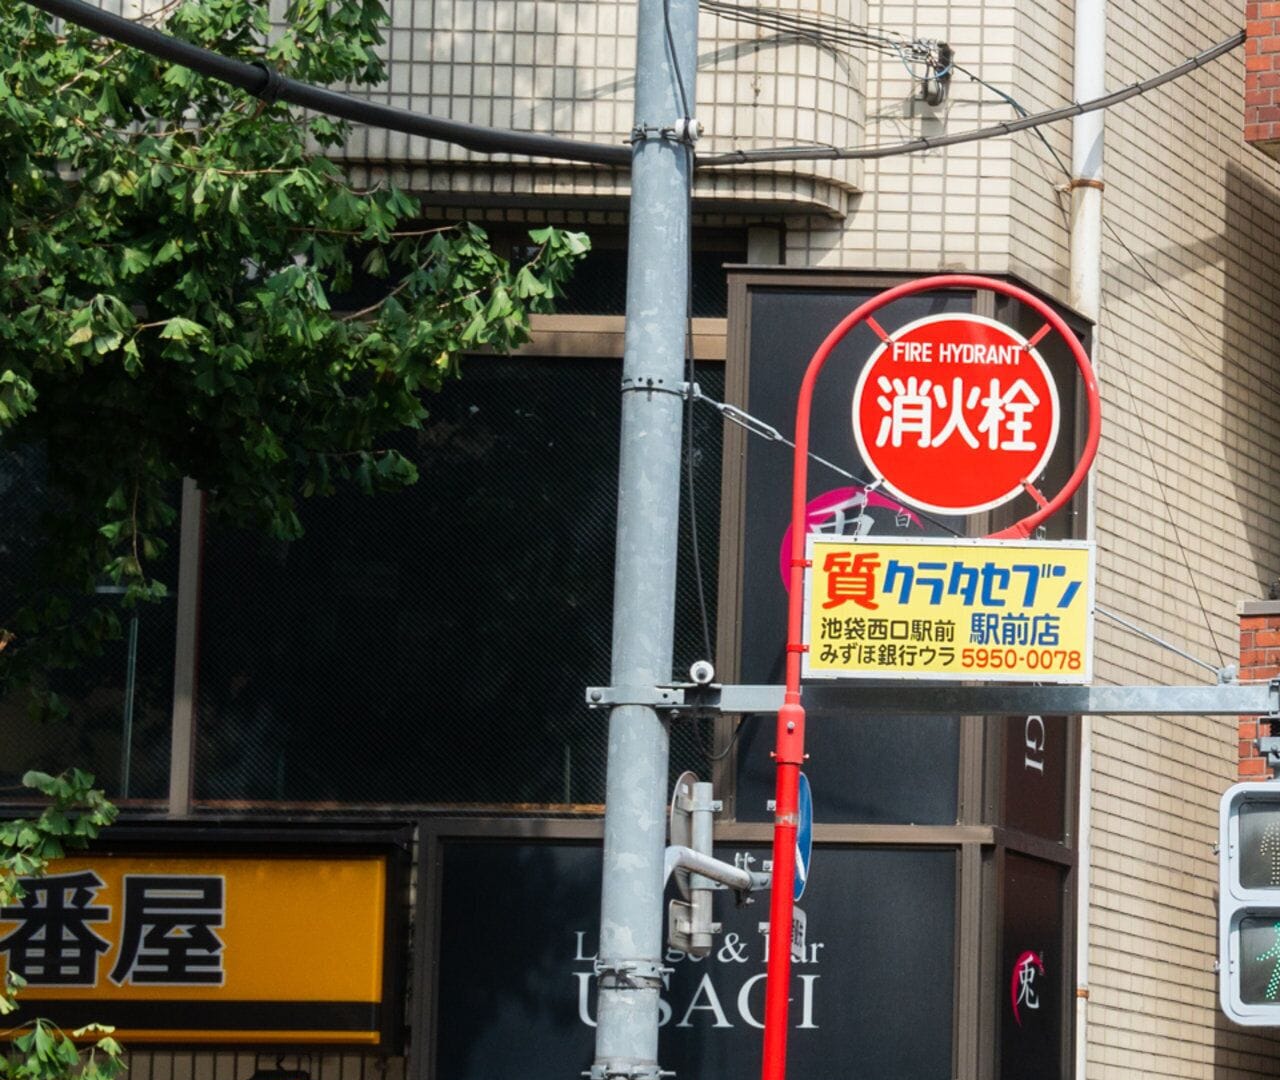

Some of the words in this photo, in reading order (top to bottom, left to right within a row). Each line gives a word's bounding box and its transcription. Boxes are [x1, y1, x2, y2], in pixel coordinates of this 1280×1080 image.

[893, 342, 932, 363] FIRE
[939, 343, 1022, 365] HYDRANT
[875, 375, 1040, 451] 消火栓
[821, 551, 881, 610] 質
[882, 558, 1083, 609] クラタセブン
[819, 616, 957, 643] 池袋西口駅前
[968, 611, 1061, 647] 駅前店
[819, 642, 956, 667] みずほ銀行ウラ
[961, 649, 1082, 670] 5950-0078
[717, 932, 749, 963] &
